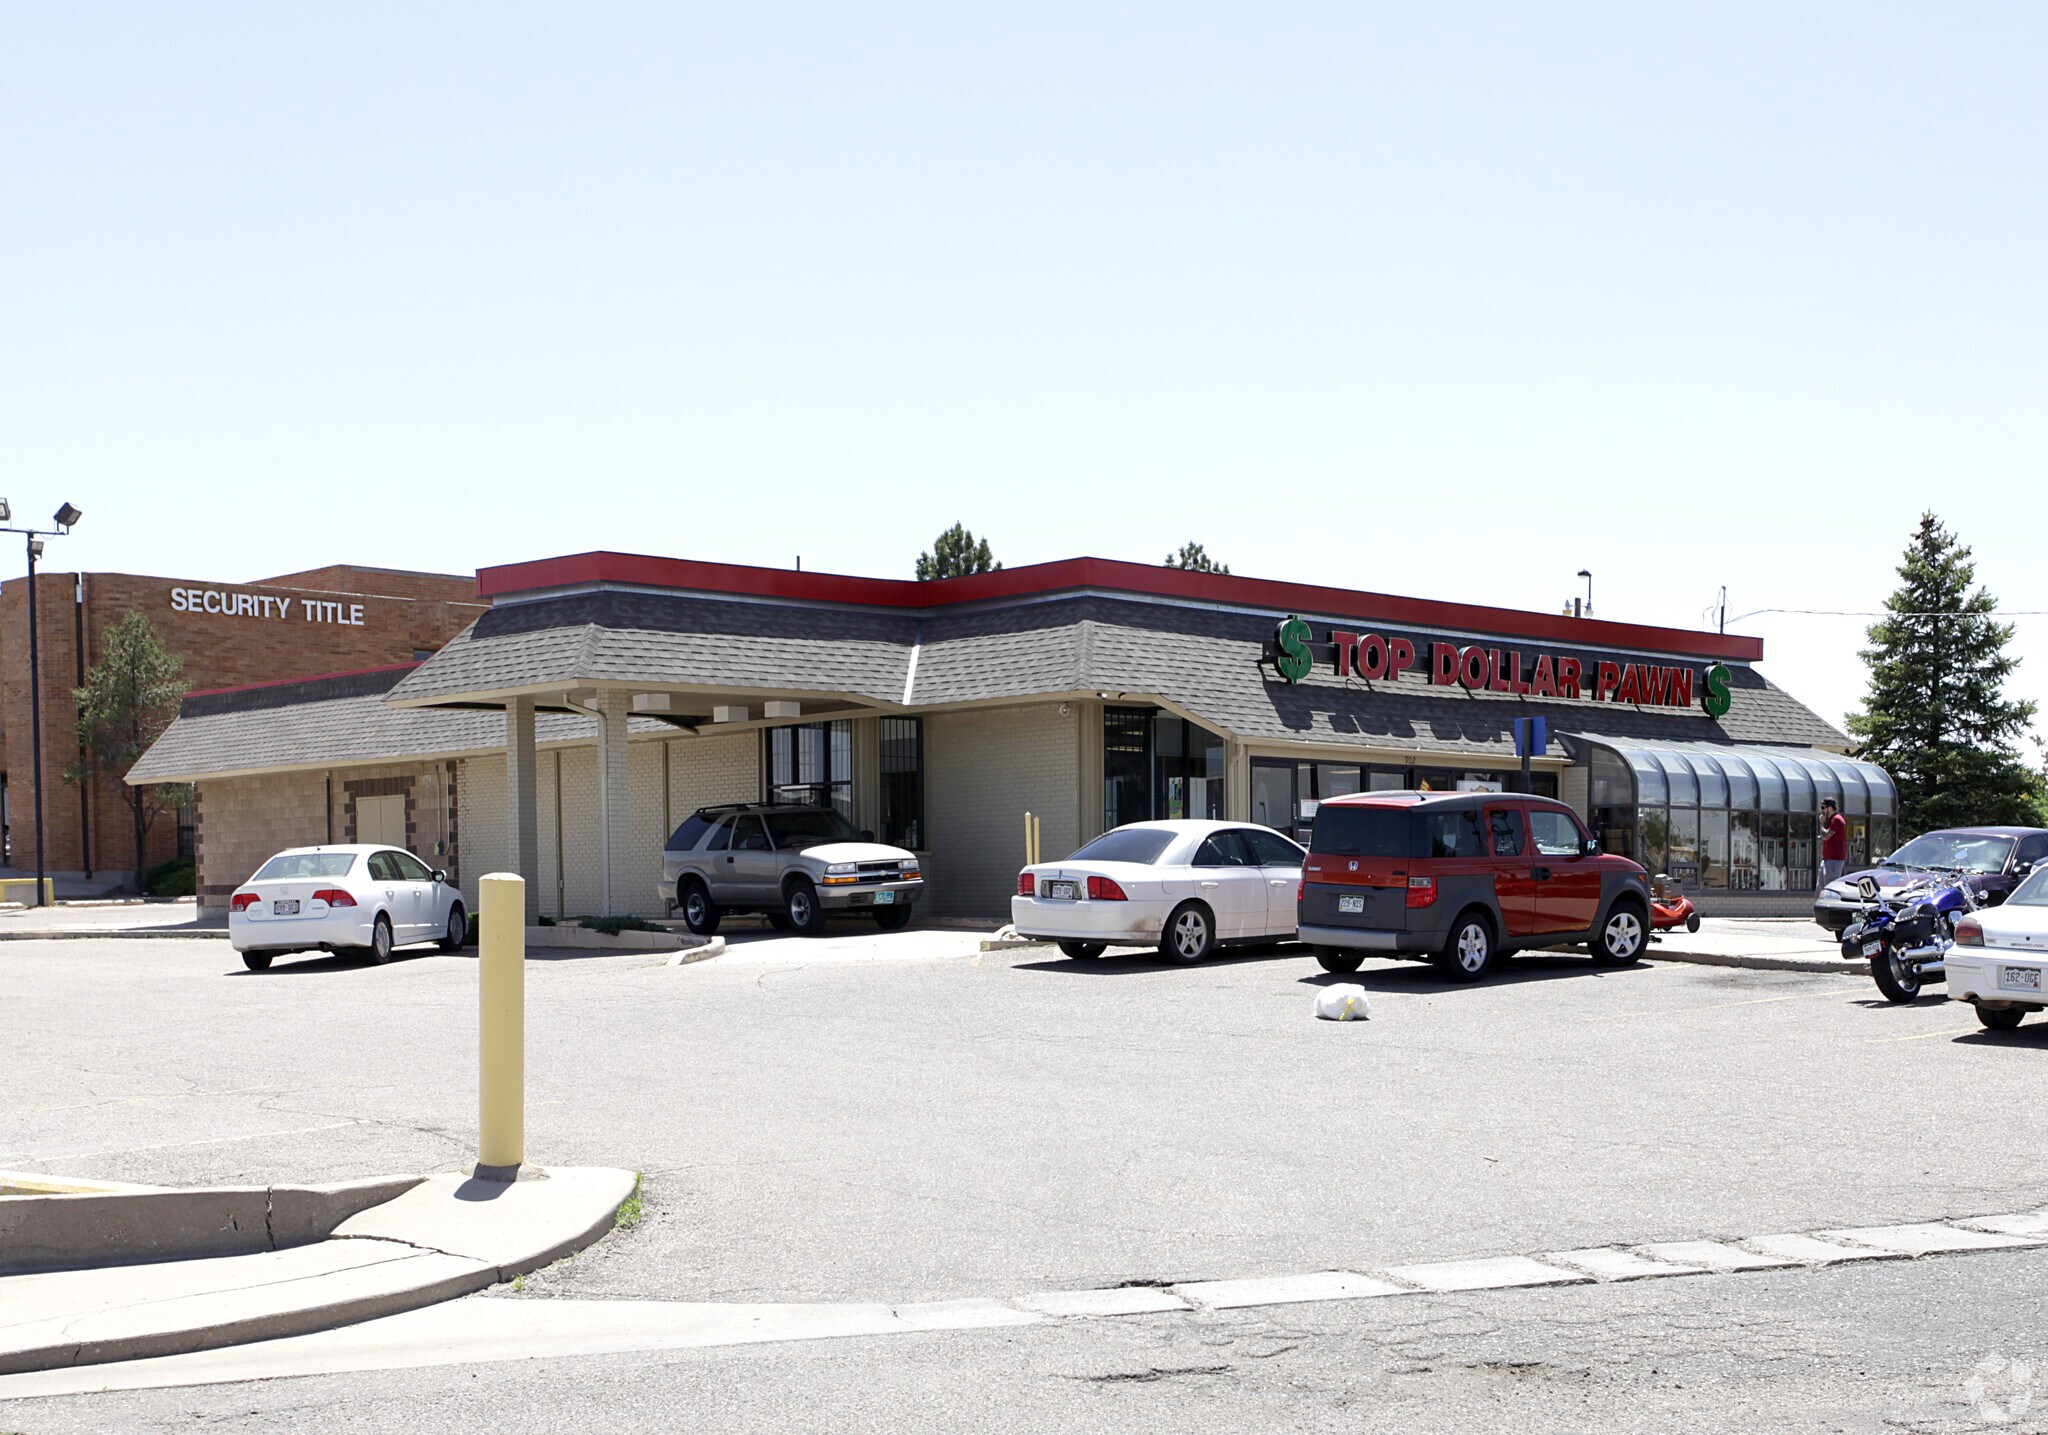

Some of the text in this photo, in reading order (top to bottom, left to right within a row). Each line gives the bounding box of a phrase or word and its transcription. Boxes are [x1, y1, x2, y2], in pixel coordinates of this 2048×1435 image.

[171, 587, 365, 626] SECURITY TITLE
[1329, 630, 1416, 681] TOP
[1431, 641, 1583, 700] DOLLAR
[1595, 660, 1694, 708] PAWN
